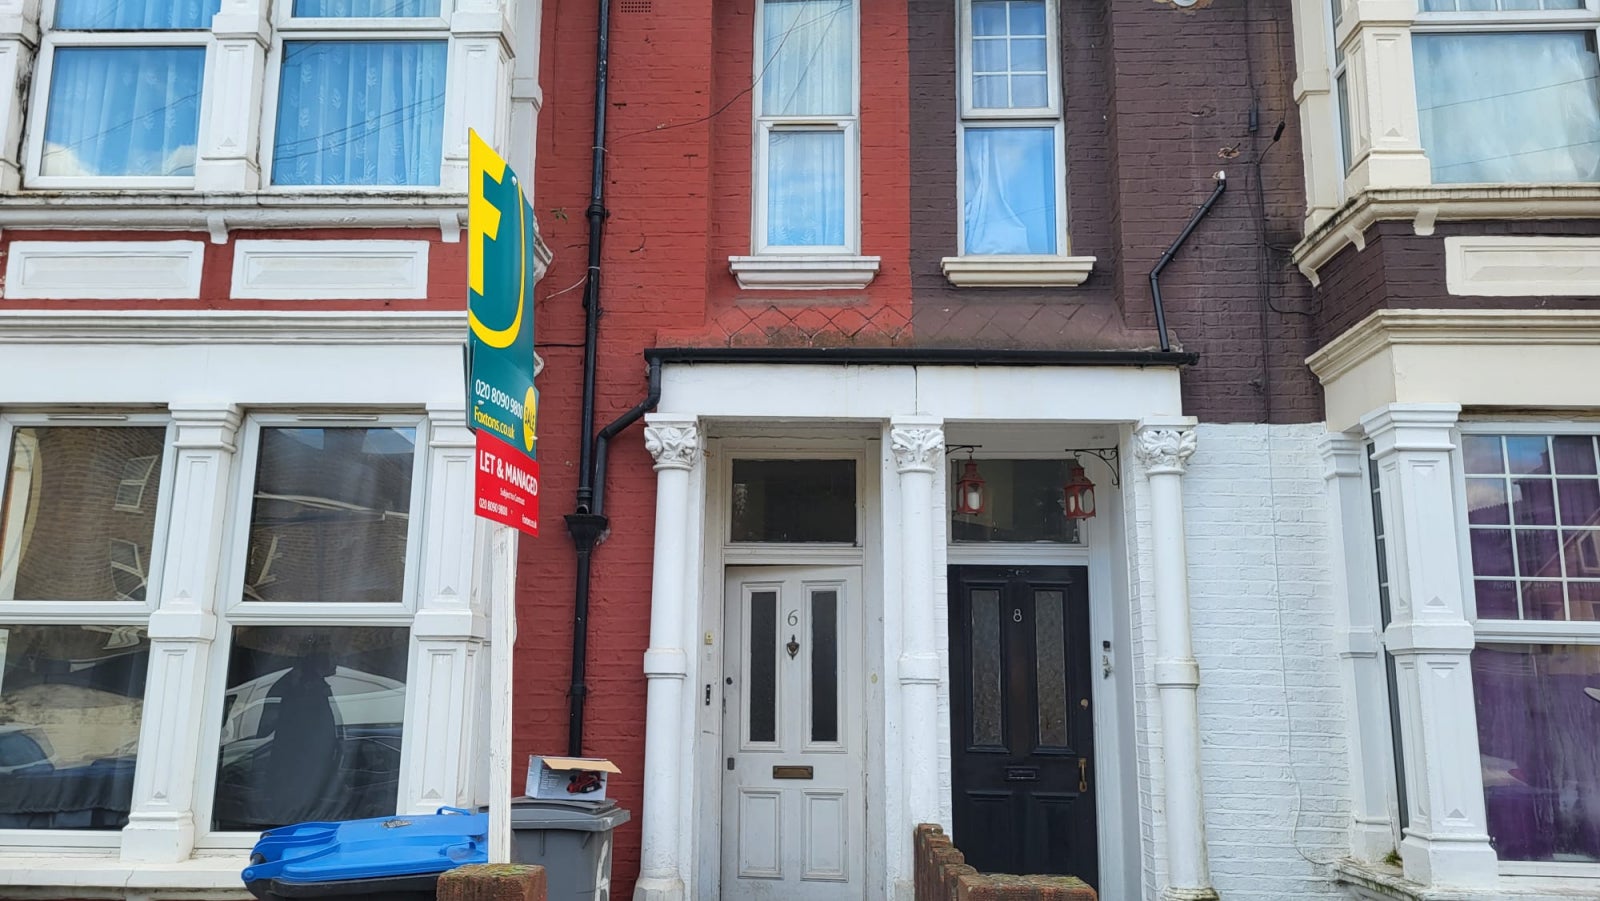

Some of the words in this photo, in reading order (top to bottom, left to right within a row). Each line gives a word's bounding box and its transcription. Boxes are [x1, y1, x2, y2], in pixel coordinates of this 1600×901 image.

[475, 379, 491, 400] 020
[491, 387, 510, 411] 8090
[510, 397, 523, 420] 9800
[474, 405, 515, 440] Foxtons.co.uk
[480, 449, 496, 475] LET
[496, 458, 505, 480] &
[505, 461, 538, 497] MANAGED
[787, 609, 799, 626] 6
[1013, 608, 1022, 622] 8
